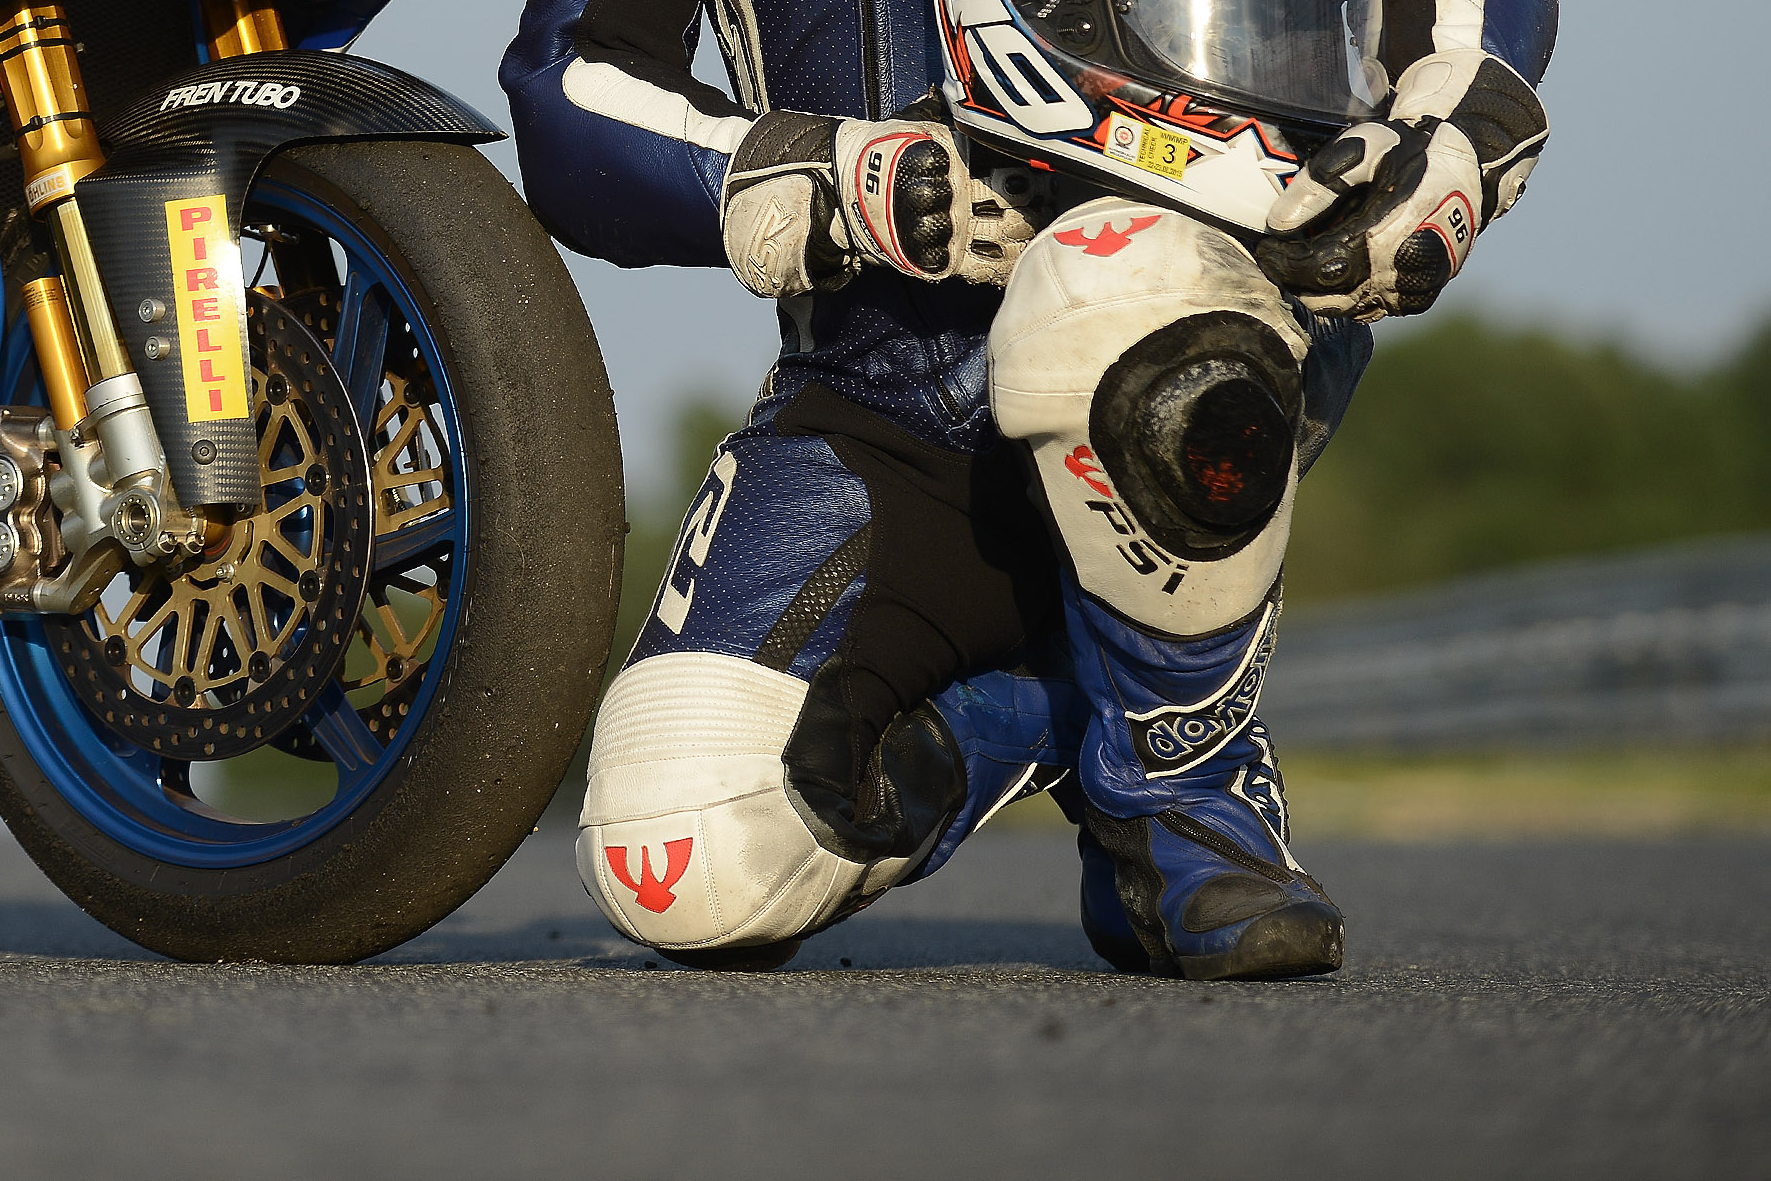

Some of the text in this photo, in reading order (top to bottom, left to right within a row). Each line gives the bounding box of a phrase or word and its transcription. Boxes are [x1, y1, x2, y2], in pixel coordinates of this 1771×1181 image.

[159, 81, 301, 111] FREN TUBO
[1162, 144, 1176, 164] 3
[180, 207, 228, 412] PIRELLI
